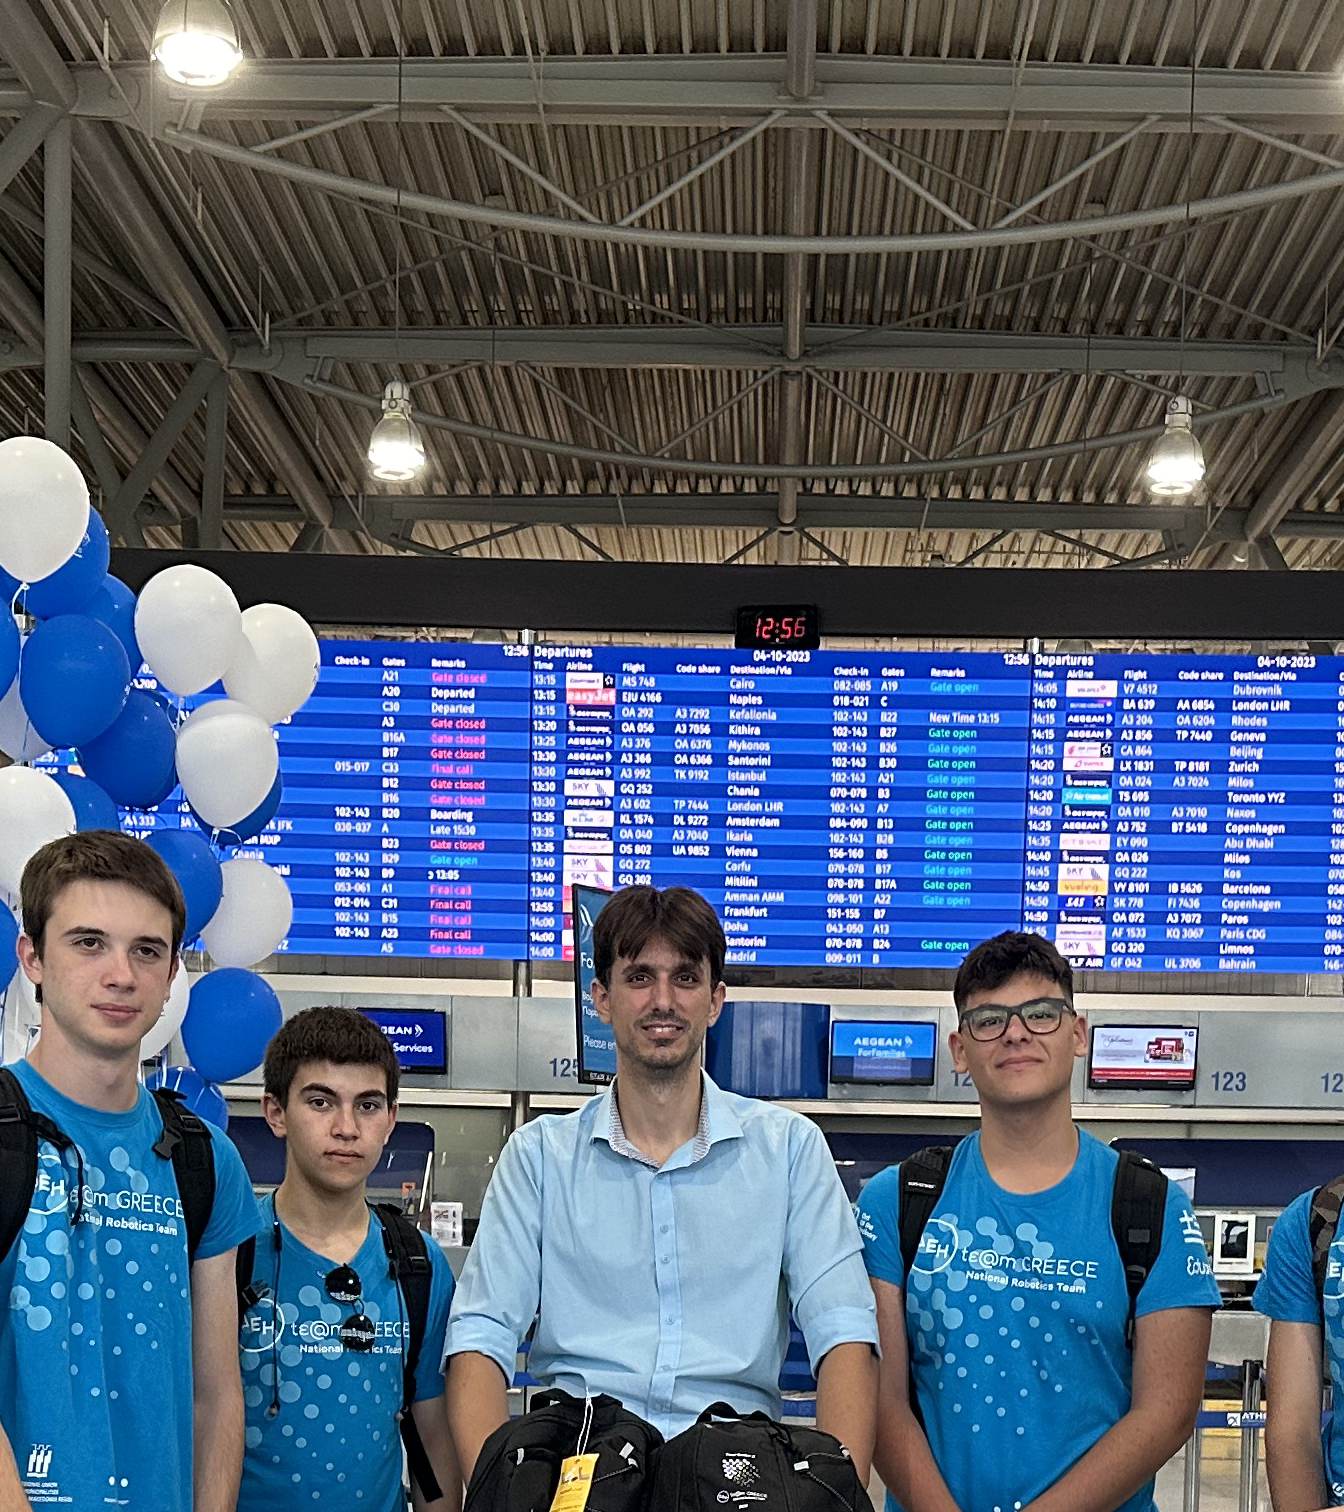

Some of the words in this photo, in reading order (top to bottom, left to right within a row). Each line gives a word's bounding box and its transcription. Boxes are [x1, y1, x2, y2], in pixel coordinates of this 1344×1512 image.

[756, 618, 806, 638] 12:56
[502, 645, 530, 657] 12:56
[534, 646, 593, 660] Departures
[753, 651, 810, 662] 04-10-2023
[335, 656, 370, 666] Check-in
[566, 662, 593, 671] Airline
[1034, 656, 1094, 667] Departures
[1258, 656, 1316, 668] 04-10-2023
[676, 664, 696, 673] Code
[698, 665, 721, 674] share
[833, 666, 869, 677] Check-in
[1178, 670, 1199, 680] Code
[1201, 672, 1224, 680] share
[730, 678, 755, 690] Cairo
[881, 681, 898, 691] A19
[431, 687, 475, 700] Departed
[640, 692, 662, 703] 4166
[729, 694, 763, 706] Naples
[1232, 700, 1268, 711] London
[930, 712, 950, 723] New
[952, 712, 975, 723] Time
[978, 714, 999, 724] 13:15
[1232, 715, 1267, 726] Rhodes
[622, 724, 635, 733] OA
[637, 724, 654, 733] 056
[675, 724, 687, 734] A3
[689, 724, 710, 734] 7056
[729, 725, 761, 736] Kithira
[832, 727, 867, 737] 102-143
[880, 727, 897, 738] B27
[928, 728, 950, 738] Gate
[953, 730, 977, 741] open
[1230, 731, 1266, 742] Geneva
[568, 738, 604, 746] AEGEAN
[728, 740, 770, 753] Mykonos
[728, 755, 771, 766] Santorini
[335, 762, 370, 772] 015-017
[1228, 761, 1259, 772] Zurich
[728, 770, 766, 781] Istanbul
[727, 786, 759, 797] Chania
[1227, 792, 1265, 802] Toronto
[1268, 792, 1285, 802] YYZ
[727, 801, 762, 812] London
[765, 802, 783, 812] LHR
[430, 809, 473, 822] Boarding
[726, 816, 780, 828] Amsterdam
[430, 824, 450, 834] Late
[453, 824, 476, 835] 15:30
[1225, 822, 1285, 834] Copenhagen
[726, 831, 753, 842] Ikaria
[725, 846, 758, 857] Vienna
[1222, 883, 1271, 894] Barcelona
[430, 900, 453, 910] Final
[455, 900, 471, 910] call
[724, 906, 767, 918] Frankfurt
[1222, 914, 1248, 924] Paros
[381, 1027, 412, 1035] GEAN
[584, 1035, 606, 1049] Please
[854, 1037, 902, 1046] AEGEAN
[393, 1043, 433, 1053] Services
[1211, 1071, 1247, 1092] 123
[116, 1190, 184, 1218] GREECE
[105, 1217, 153, 1232] Robotics
[154, 1222, 177, 1236] Team
[966, 1271, 1009, 1285] National
[1012, 1277, 1054, 1291] Robotics
[1057, 1282, 1086, 1294] Team
[300, 1344, 343, 1353] National
